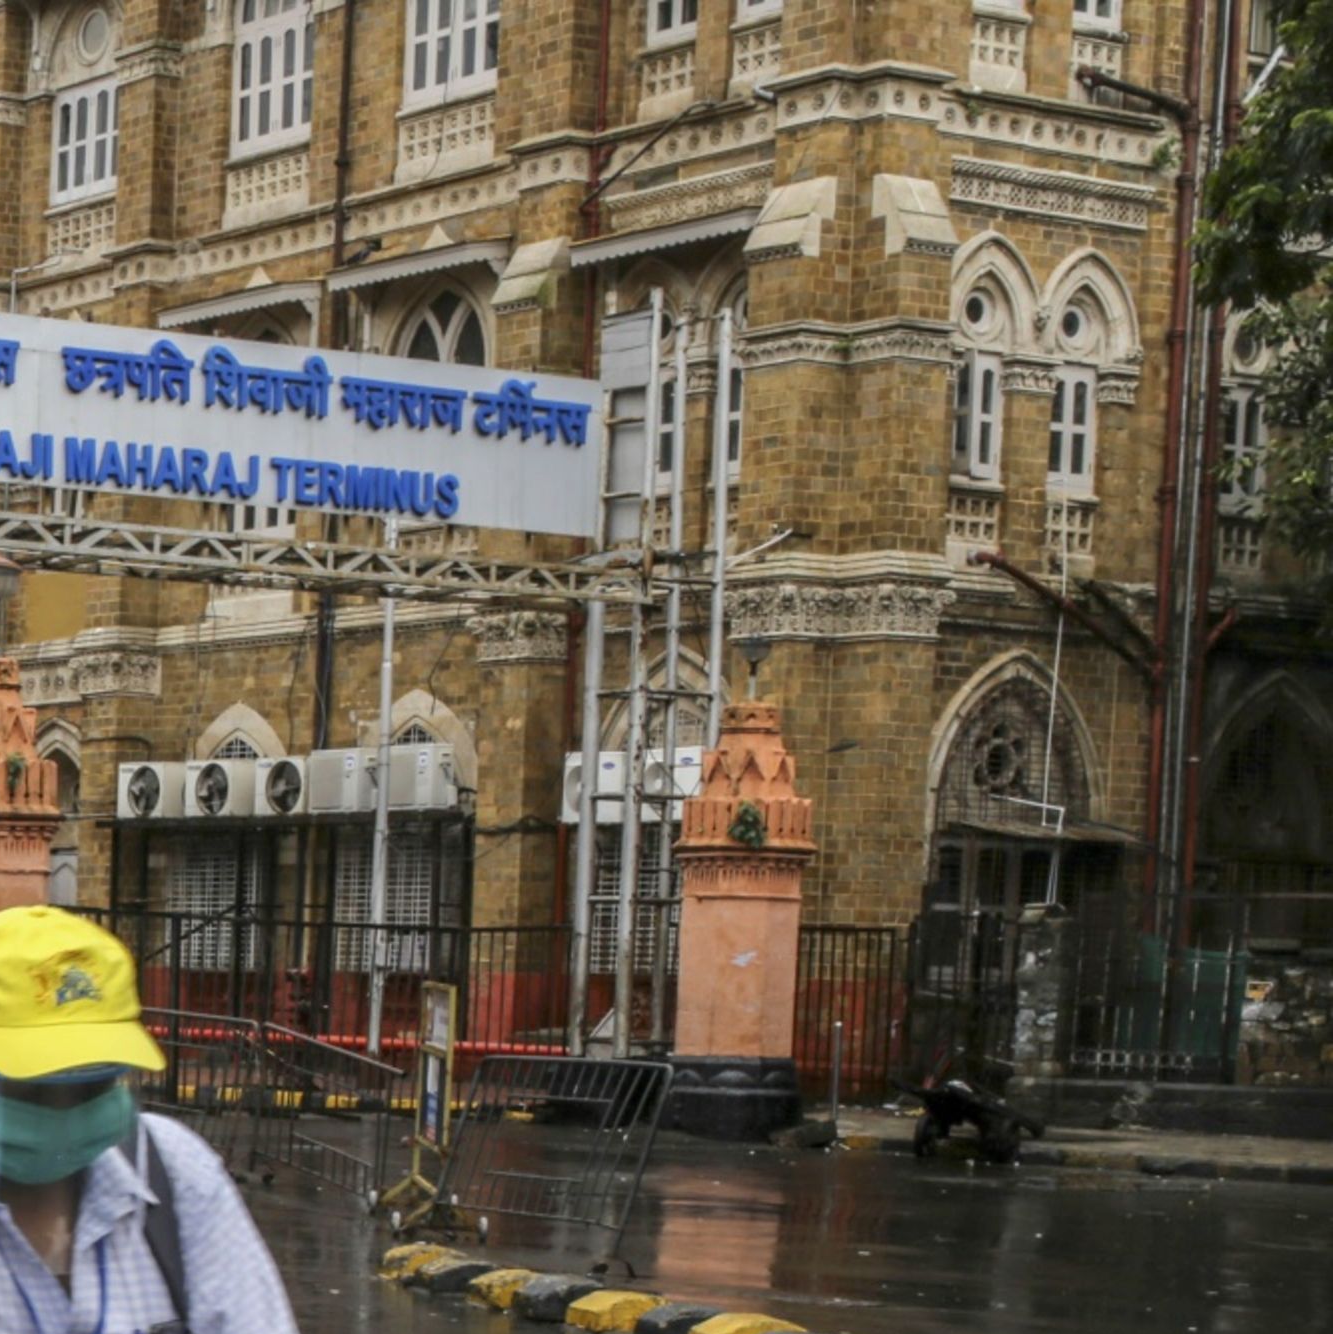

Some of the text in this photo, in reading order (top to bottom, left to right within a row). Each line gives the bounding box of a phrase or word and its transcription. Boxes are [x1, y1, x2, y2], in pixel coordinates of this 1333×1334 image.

[61, 339, 195, 405] छत्रपति
[202, 345, 333, 419] शिवाजी
[340, 376, 468, 434] महाराज
[472, 378, 592, 448] टर्मिनस
[64, 437, 260, 499] MAHARAJ
[270, 457, 460, 519] TERMINUS
